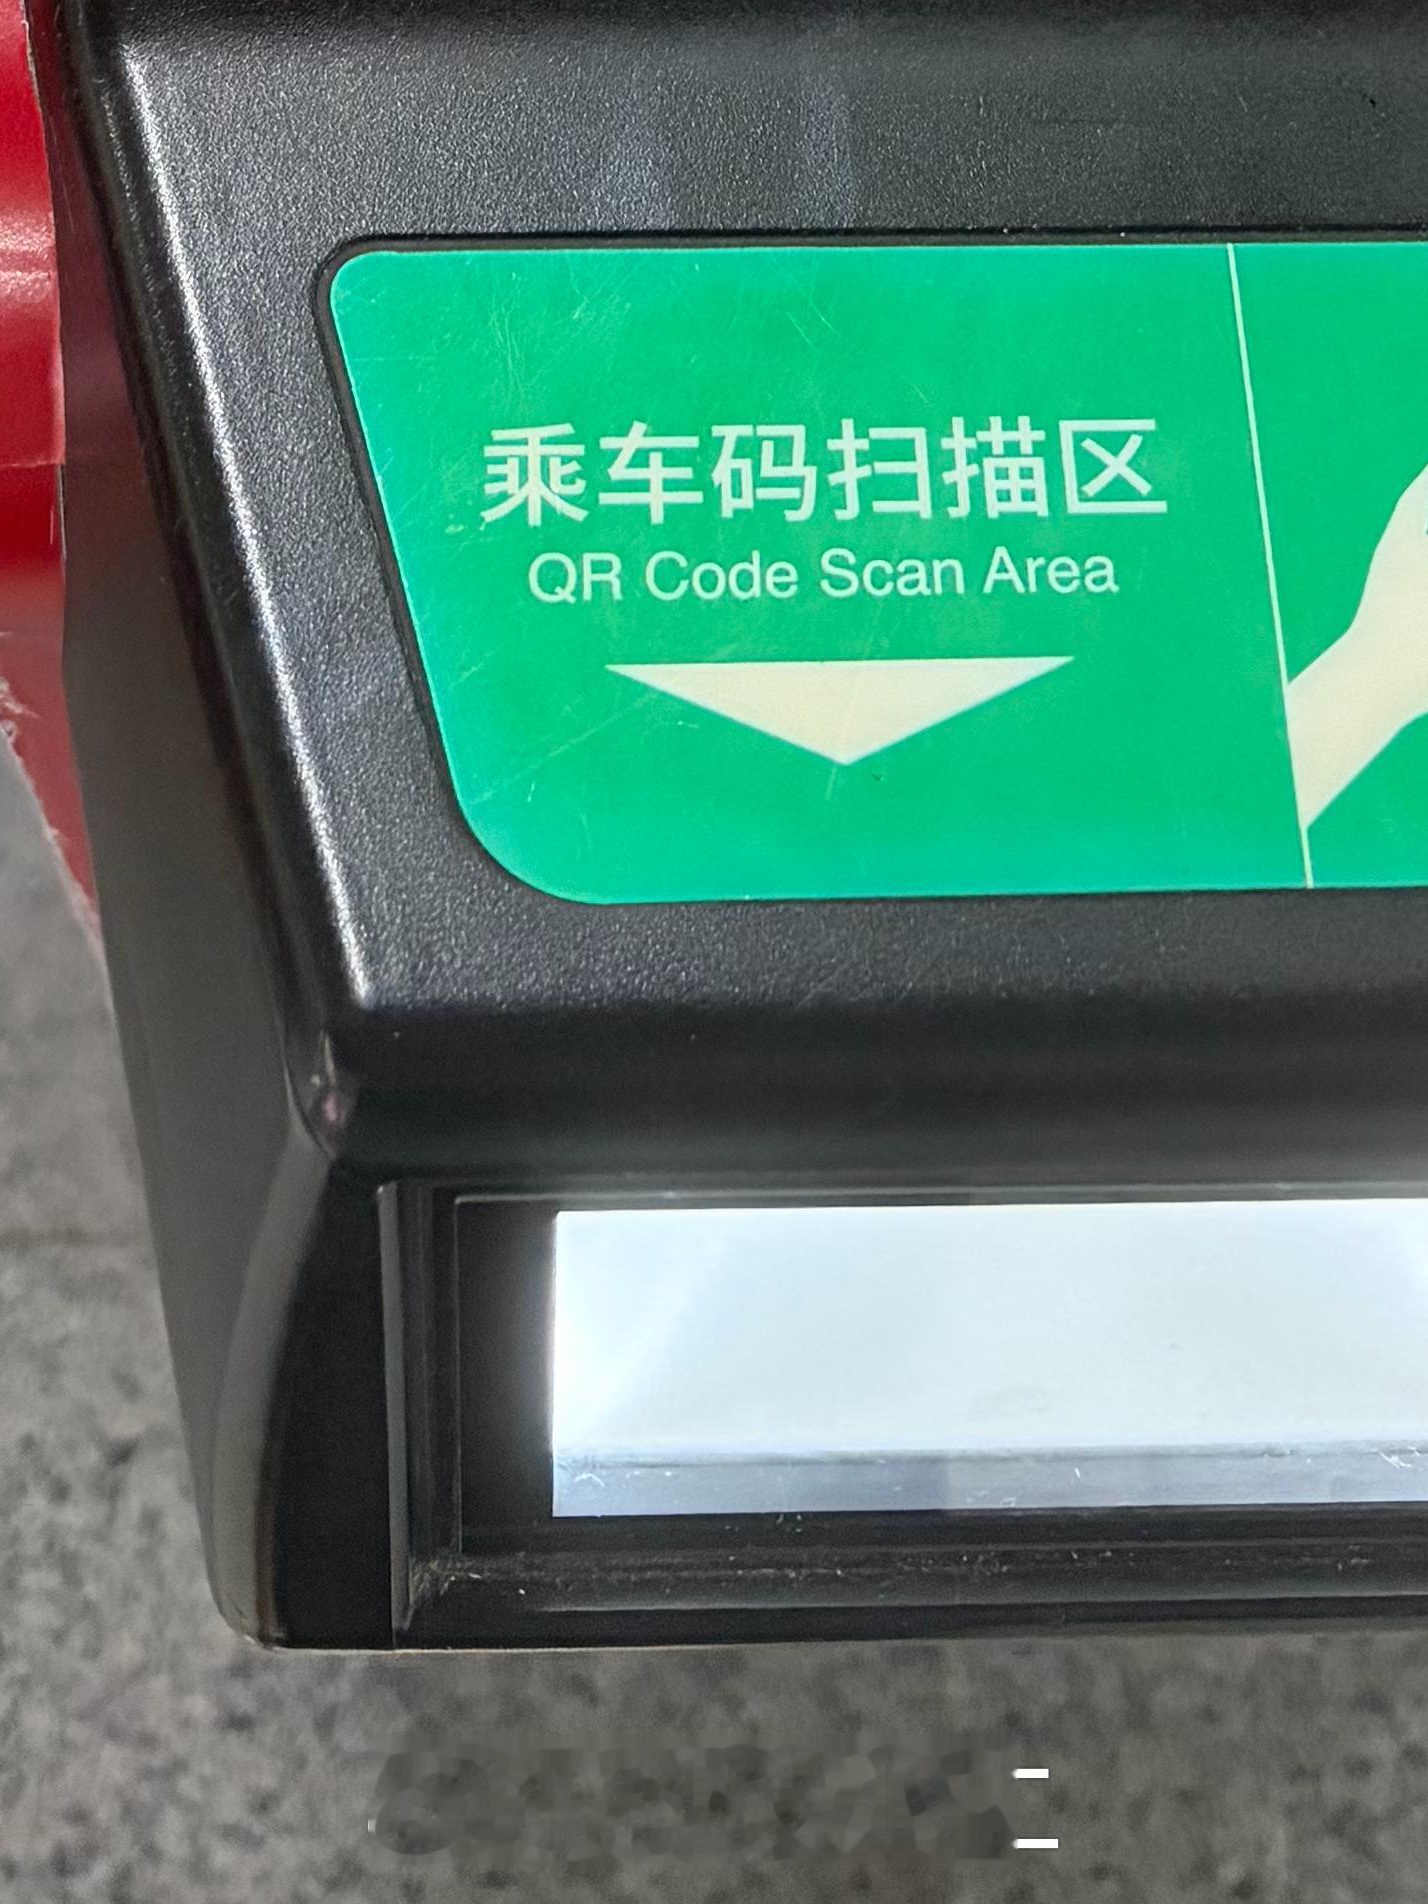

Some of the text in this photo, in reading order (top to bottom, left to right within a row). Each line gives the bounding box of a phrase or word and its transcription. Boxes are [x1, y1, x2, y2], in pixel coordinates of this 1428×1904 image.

[480, 415, 1169, 527] 乘车码扫描区
[528, 545, 1120, 603] QR Code Scan Area
